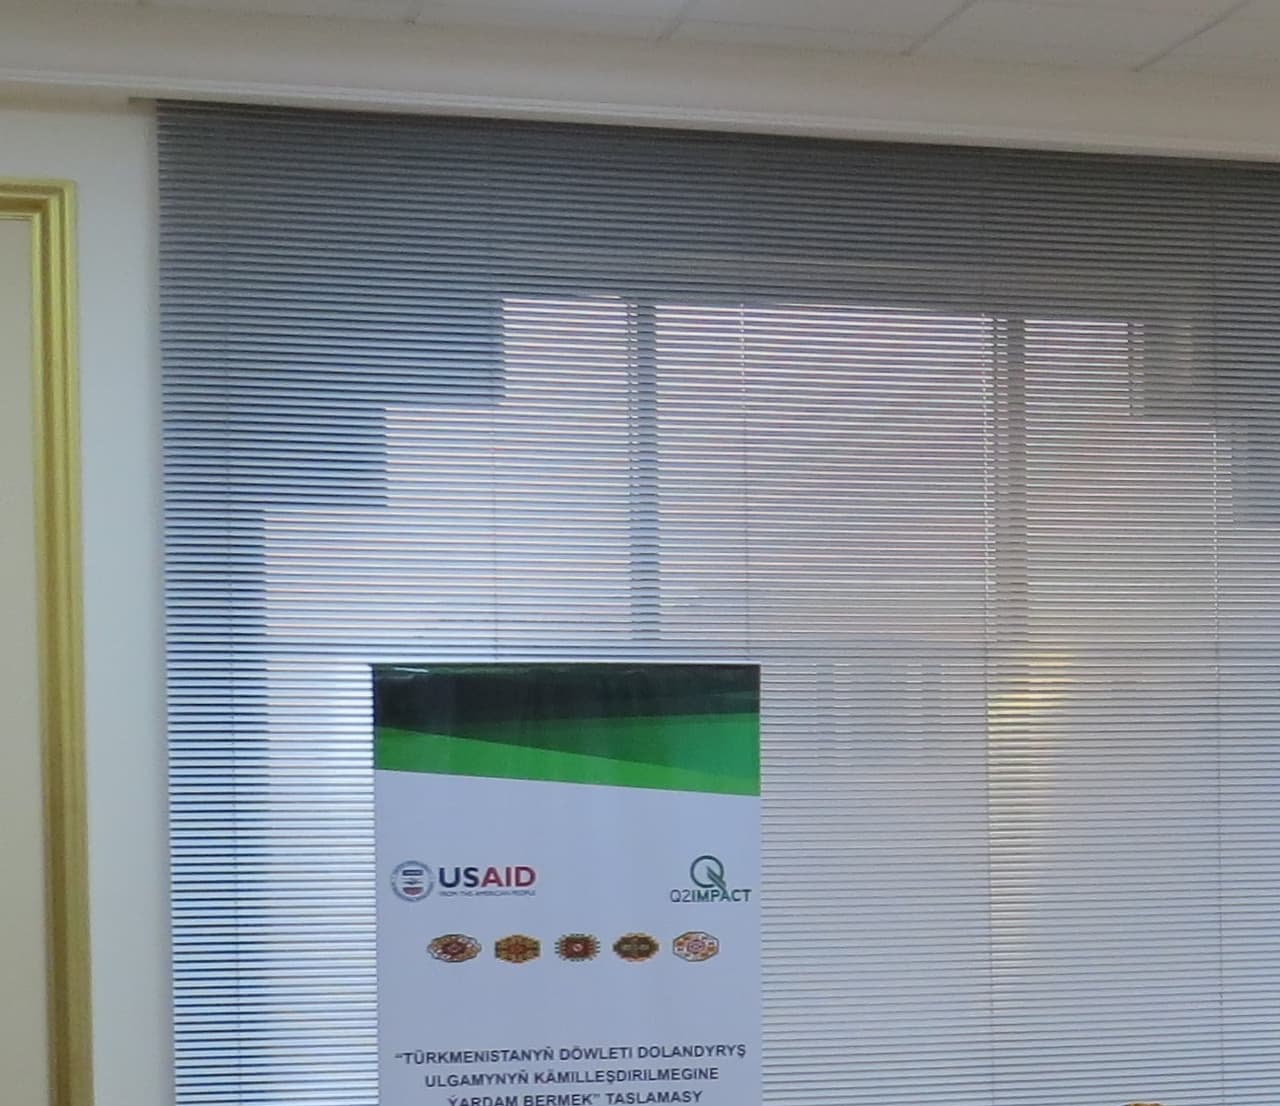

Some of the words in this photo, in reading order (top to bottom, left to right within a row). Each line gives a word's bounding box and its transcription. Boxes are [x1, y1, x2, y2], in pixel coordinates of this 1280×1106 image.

[439, 866, 537, 888] USAID
[670, 889, 752, 902] Q2IMPACT
[559, 1046, 633, 1061] DÖWLETI
[638, 1044, 746, 1059] DOLANDYRYŞ
[425, 1069, 529, 1087] ULGAMYNYŇ
[534, 1067, 719, 1085] KÄMILLEŞDIRILMEGINE
[605, 1090, 703, 1105] TASLAMASY
